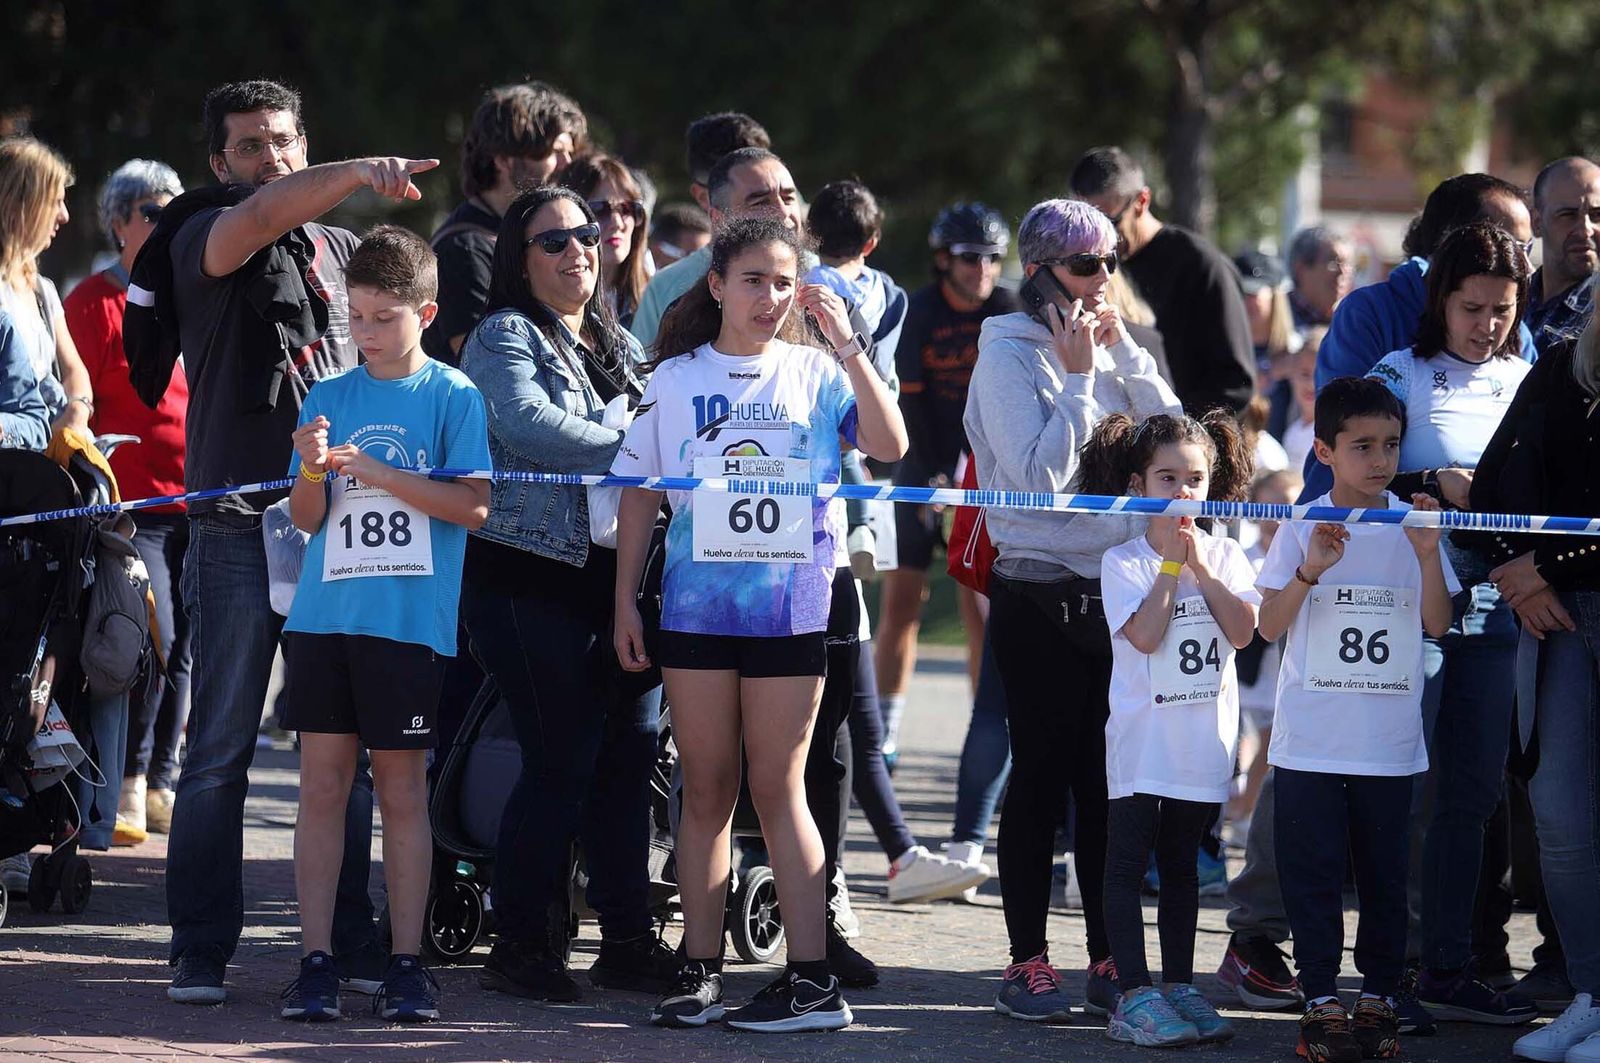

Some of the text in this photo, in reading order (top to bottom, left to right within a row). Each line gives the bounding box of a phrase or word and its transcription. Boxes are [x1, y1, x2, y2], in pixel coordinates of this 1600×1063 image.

[729, 402, 790, 421] HUELVA
[756, 465, 785, 473] HUELVA
[728, 498, 781, 534] 60
[339, 510, 412, 549] 188
[703, 549, 807, 559] Huelva eleva tus sentidos.
[330, 562, 427, 576] Huelva eleva tus sentidos.
[1338, 627, 1390, 665] 86
[1178, 637, 1221, 675] 84
[1343, 679, 1365, 689] eleva
[1367, 681, 1380, 689] tus
[1380, 680, 1410, 691] sentidos.
[1188, 690, 1209, 700] eleva
